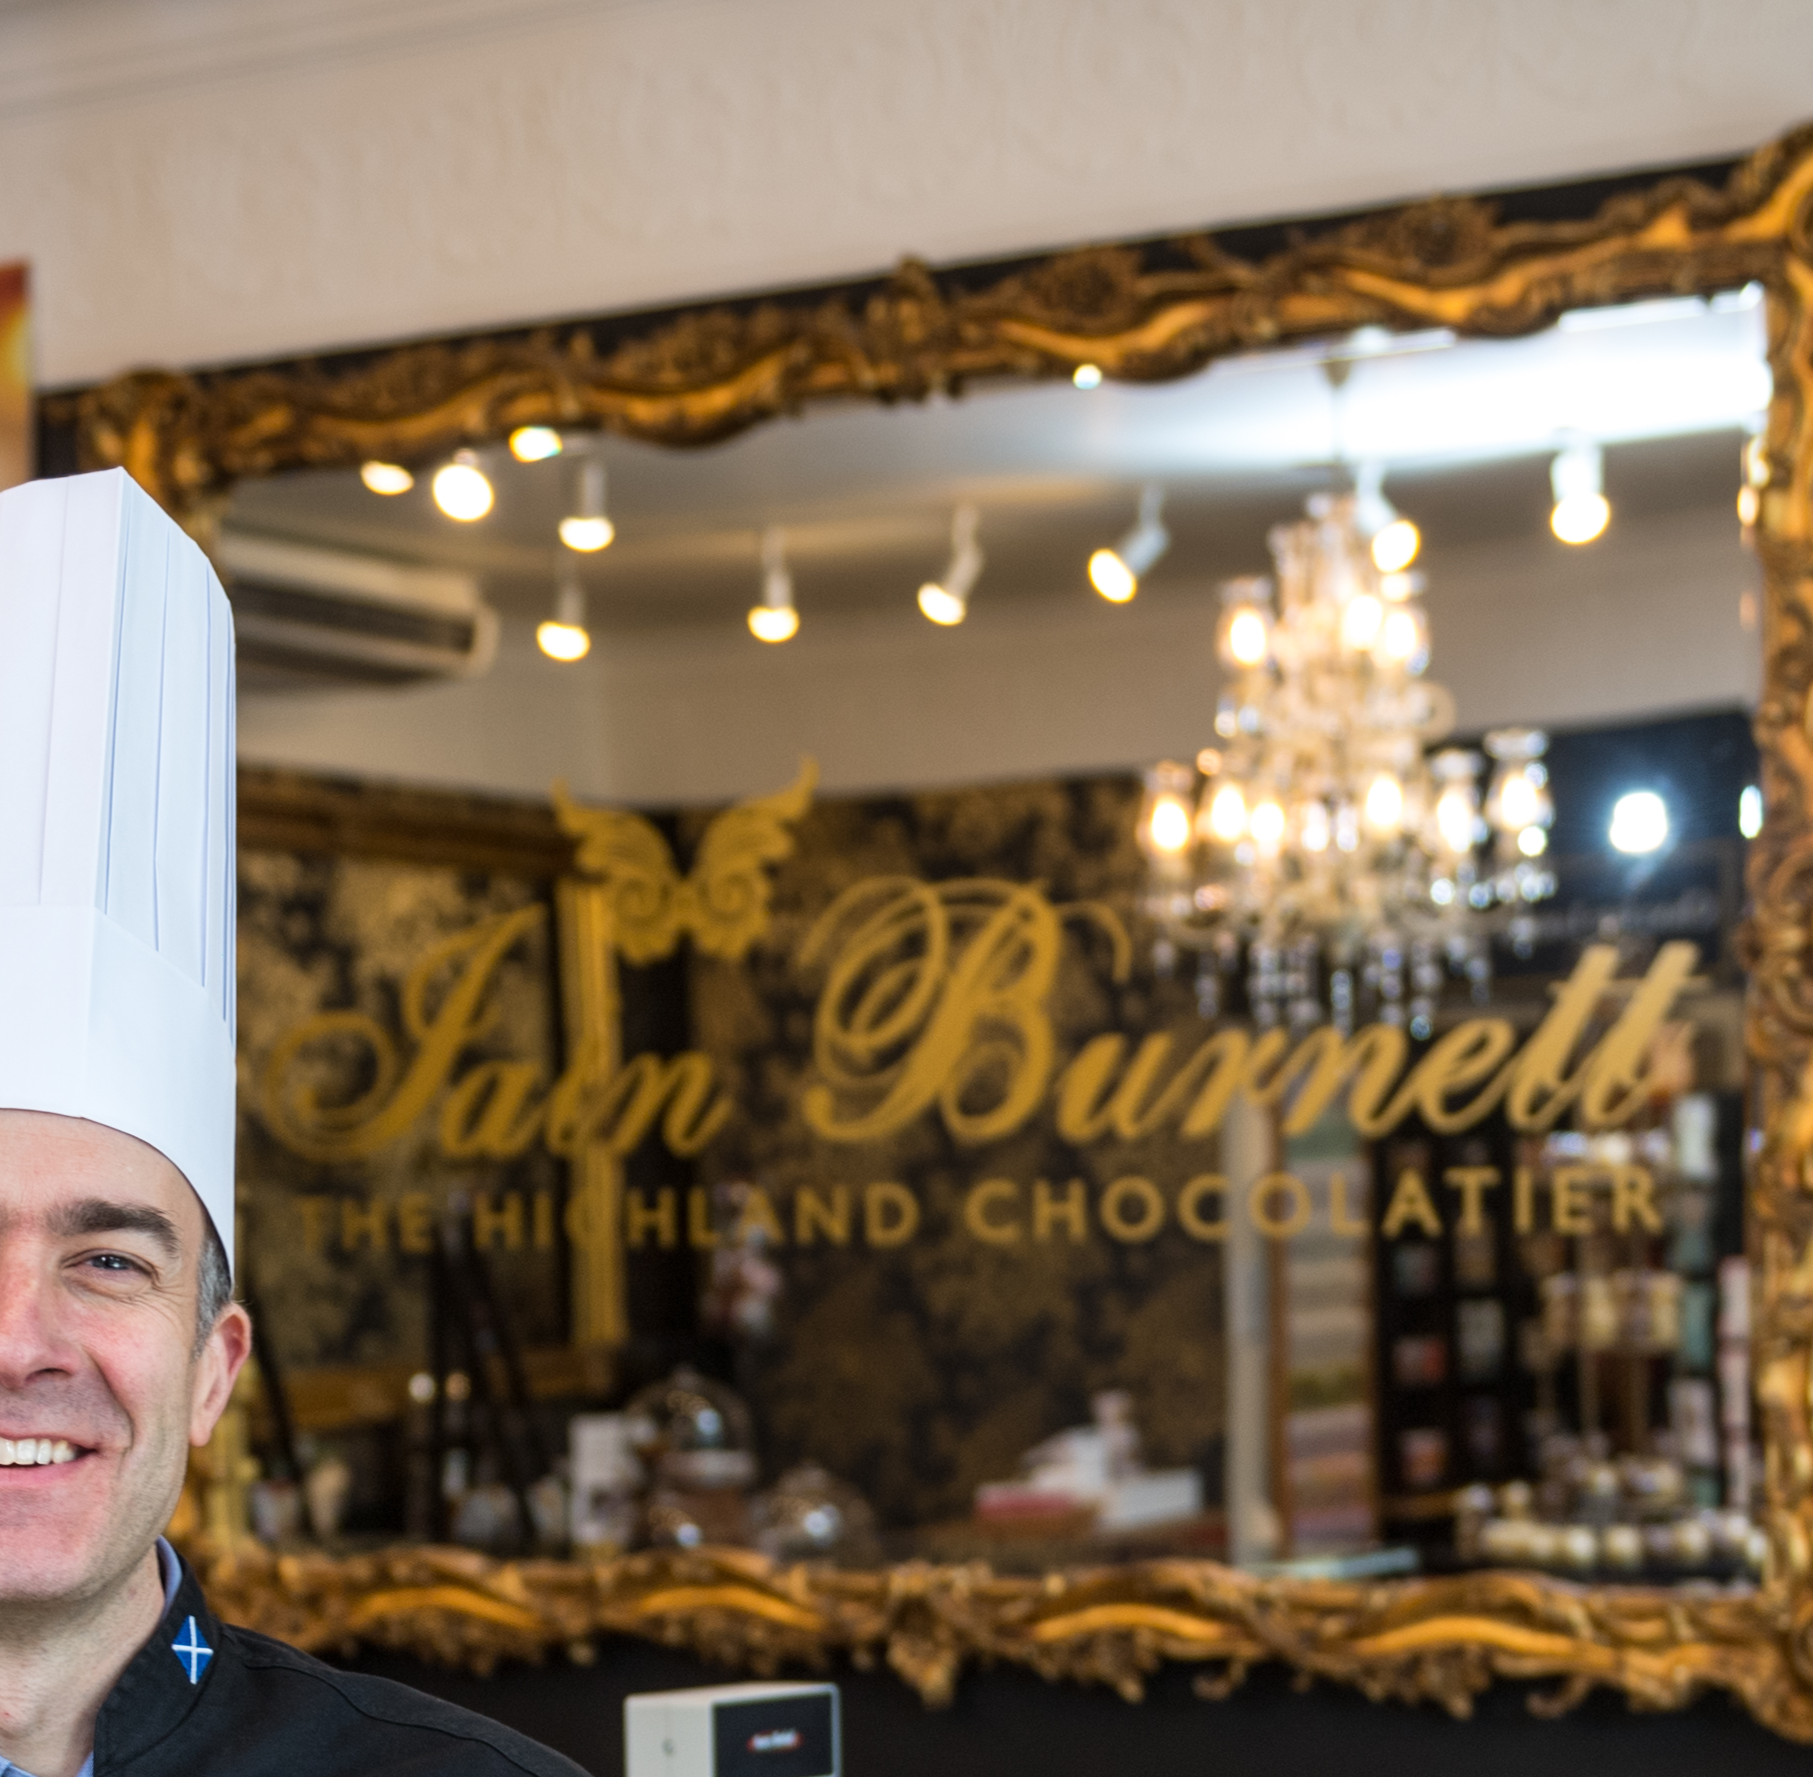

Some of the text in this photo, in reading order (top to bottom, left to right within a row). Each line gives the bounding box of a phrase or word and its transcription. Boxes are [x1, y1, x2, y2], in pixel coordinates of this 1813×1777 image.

[796, 876, 1706, 1146] Burnett
[296, 1165, 1665, 1253] THE HIGHLAND CHOCOLATIER
